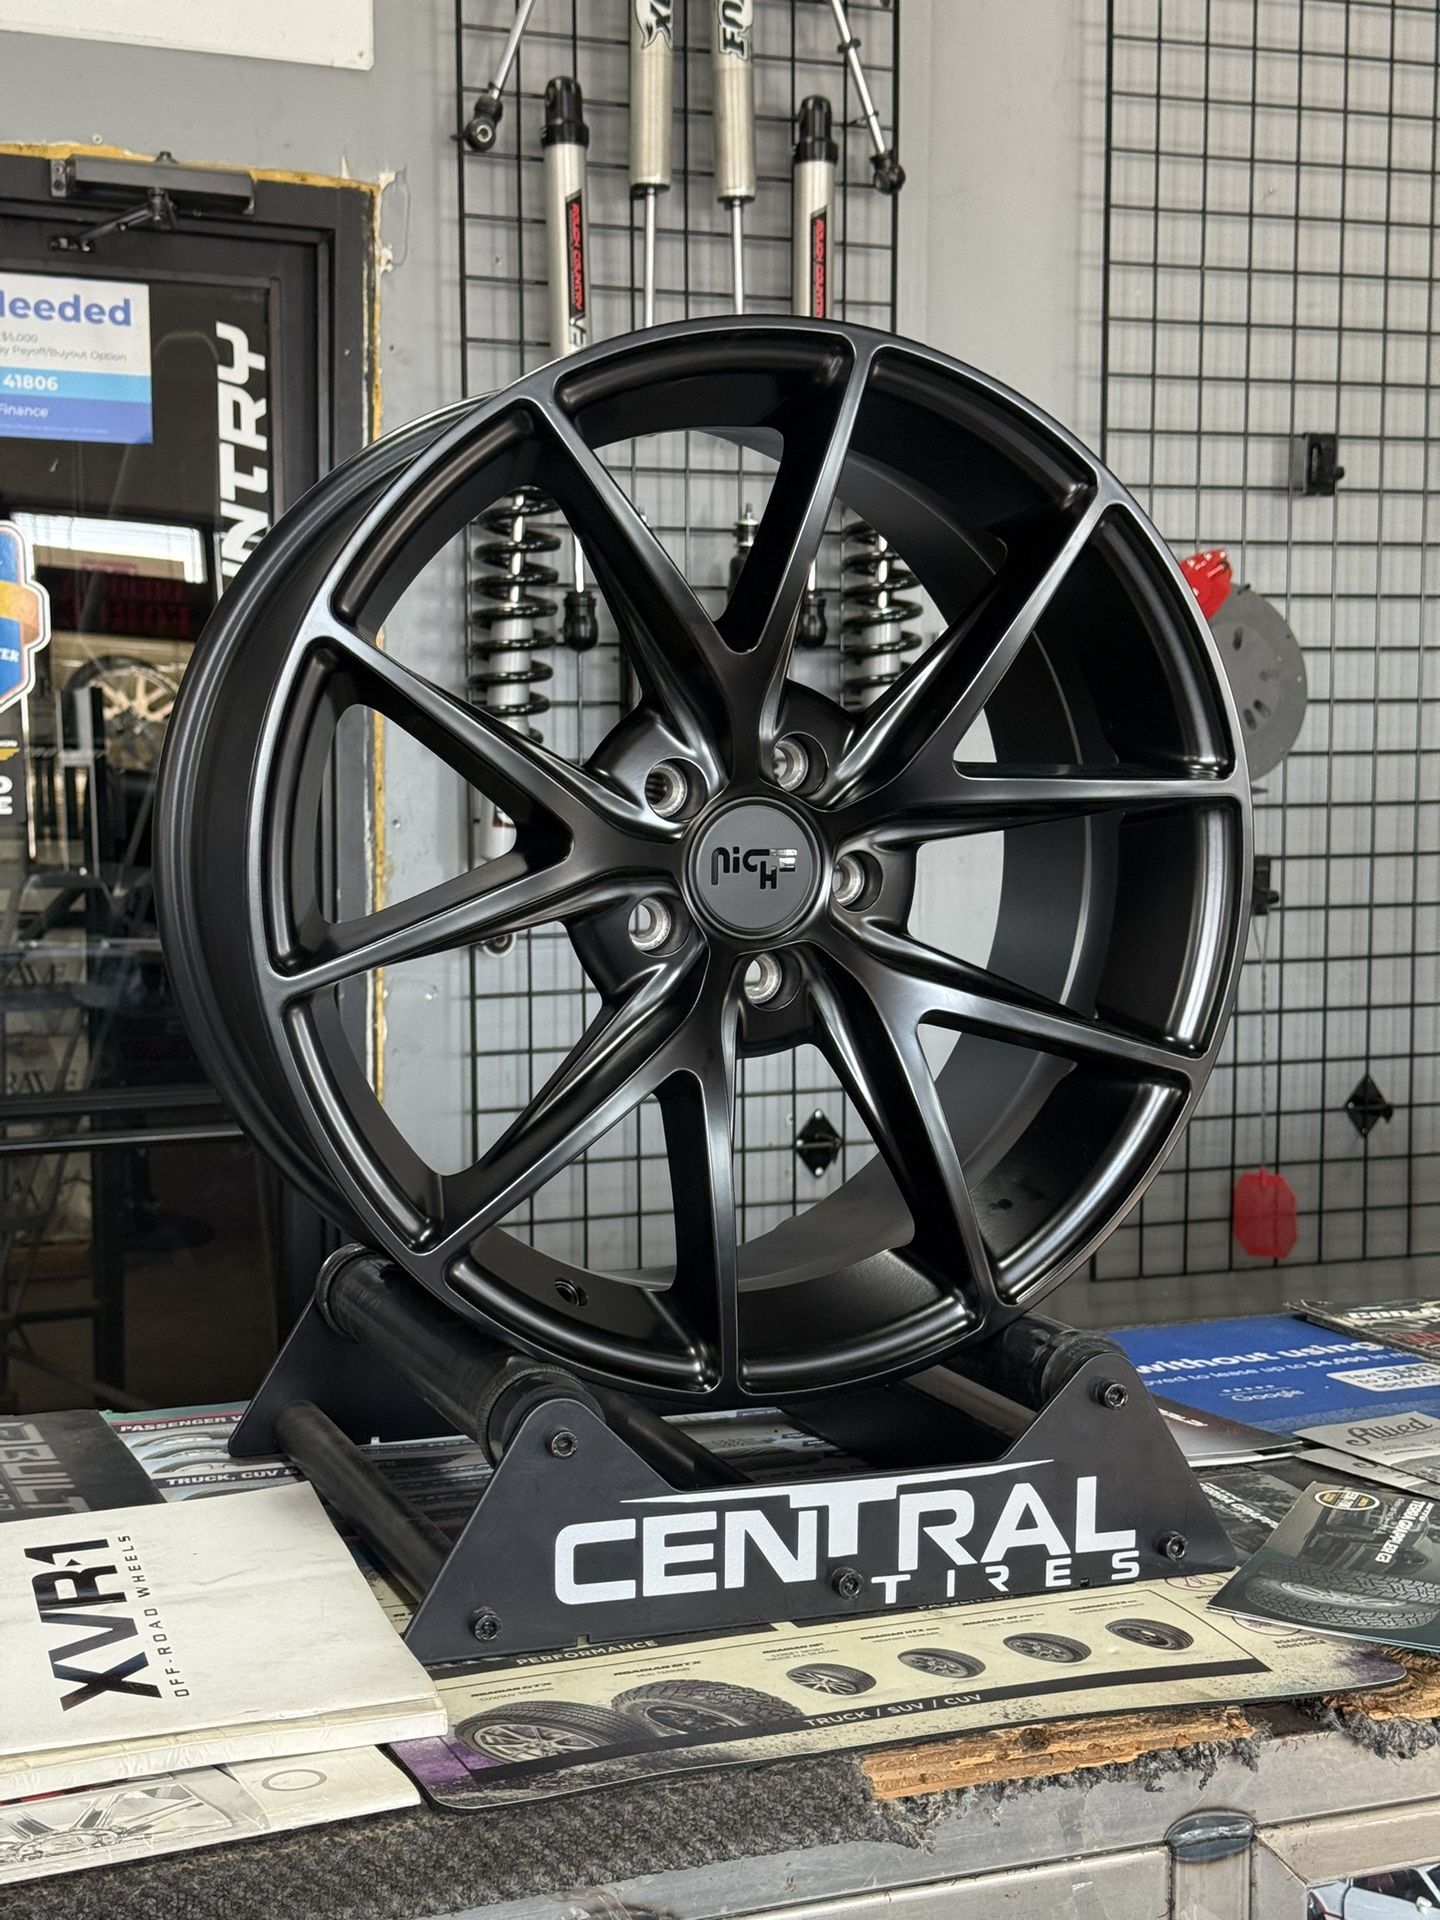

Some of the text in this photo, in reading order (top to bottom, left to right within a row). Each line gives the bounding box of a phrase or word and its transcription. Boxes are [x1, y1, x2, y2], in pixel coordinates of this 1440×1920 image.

[0, 290, 132, 326] eeded
[3, 373, 59, 391] 41806
[216, 320, 268, 577] NTRY
[1136, 1341, 1385, 1373] without using
[120, 1416, 227, 1432] PASSENGER
[1346, 1417, 1433, 1446] Allied
[241, 1469, 280, 1480] CUV
[555, 1470, 1137, 1605] CENTRAL
[872, 1549, 1139, 1604] TIRES
[118, 1535, 190, 1697] OFF-ROAD WHEELS
[516, 1639, 659, 1665] PERFORMANCE
[803, 1709, 872, 1728] TRUCK
[886, 1701, 924, 1714] SUV
[943, 1693, 982, 1706] CUV
